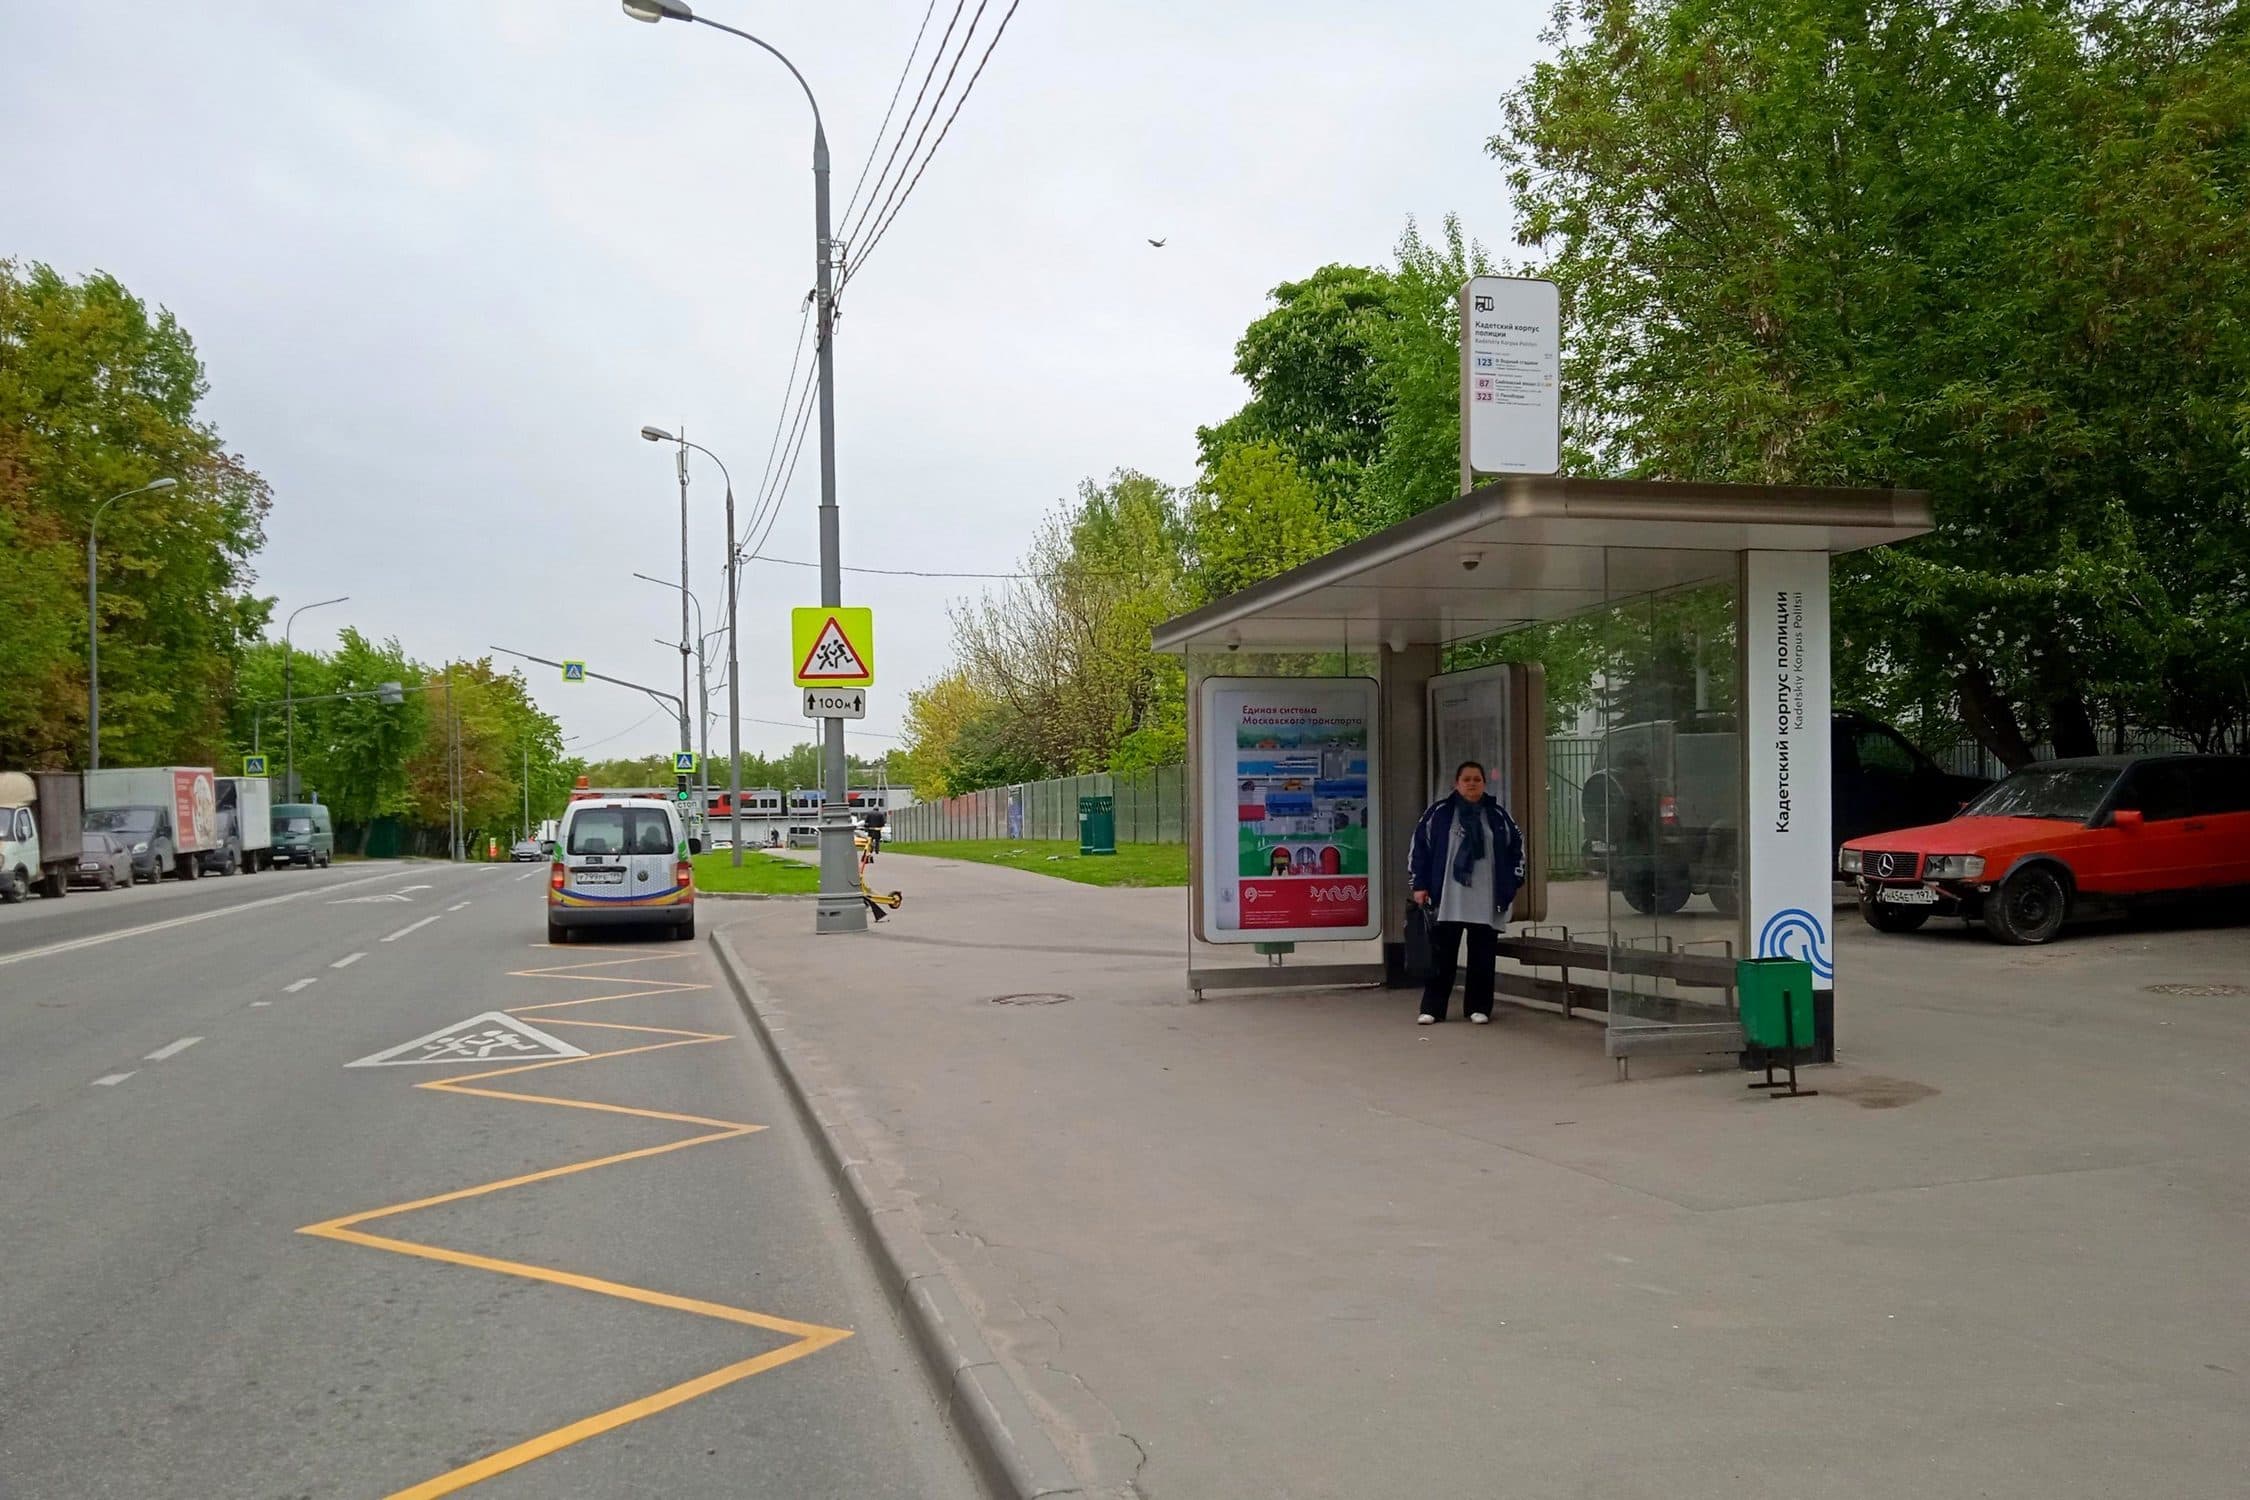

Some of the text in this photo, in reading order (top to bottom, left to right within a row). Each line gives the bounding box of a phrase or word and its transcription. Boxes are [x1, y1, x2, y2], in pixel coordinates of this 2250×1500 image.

[1475, 321, 1540, 333] Кадетский корпус
[1478, 358, 1492, 366] 123
[1479, 379, 1490, 387] 87
[1477, 393, 1492, 401] 323
[1793, 592, 1804, 730] Kadetskiy Korpus Politsii
[819, 697, 851, 709] 100м
[1242, 705, 1317, 715] Единая система
[1776, 591, 1791, 833] Кадетский корпус полиции
[1242, 716, 1362, 727] Московского транспорта
[677, 801, 697, 809] СТОП
